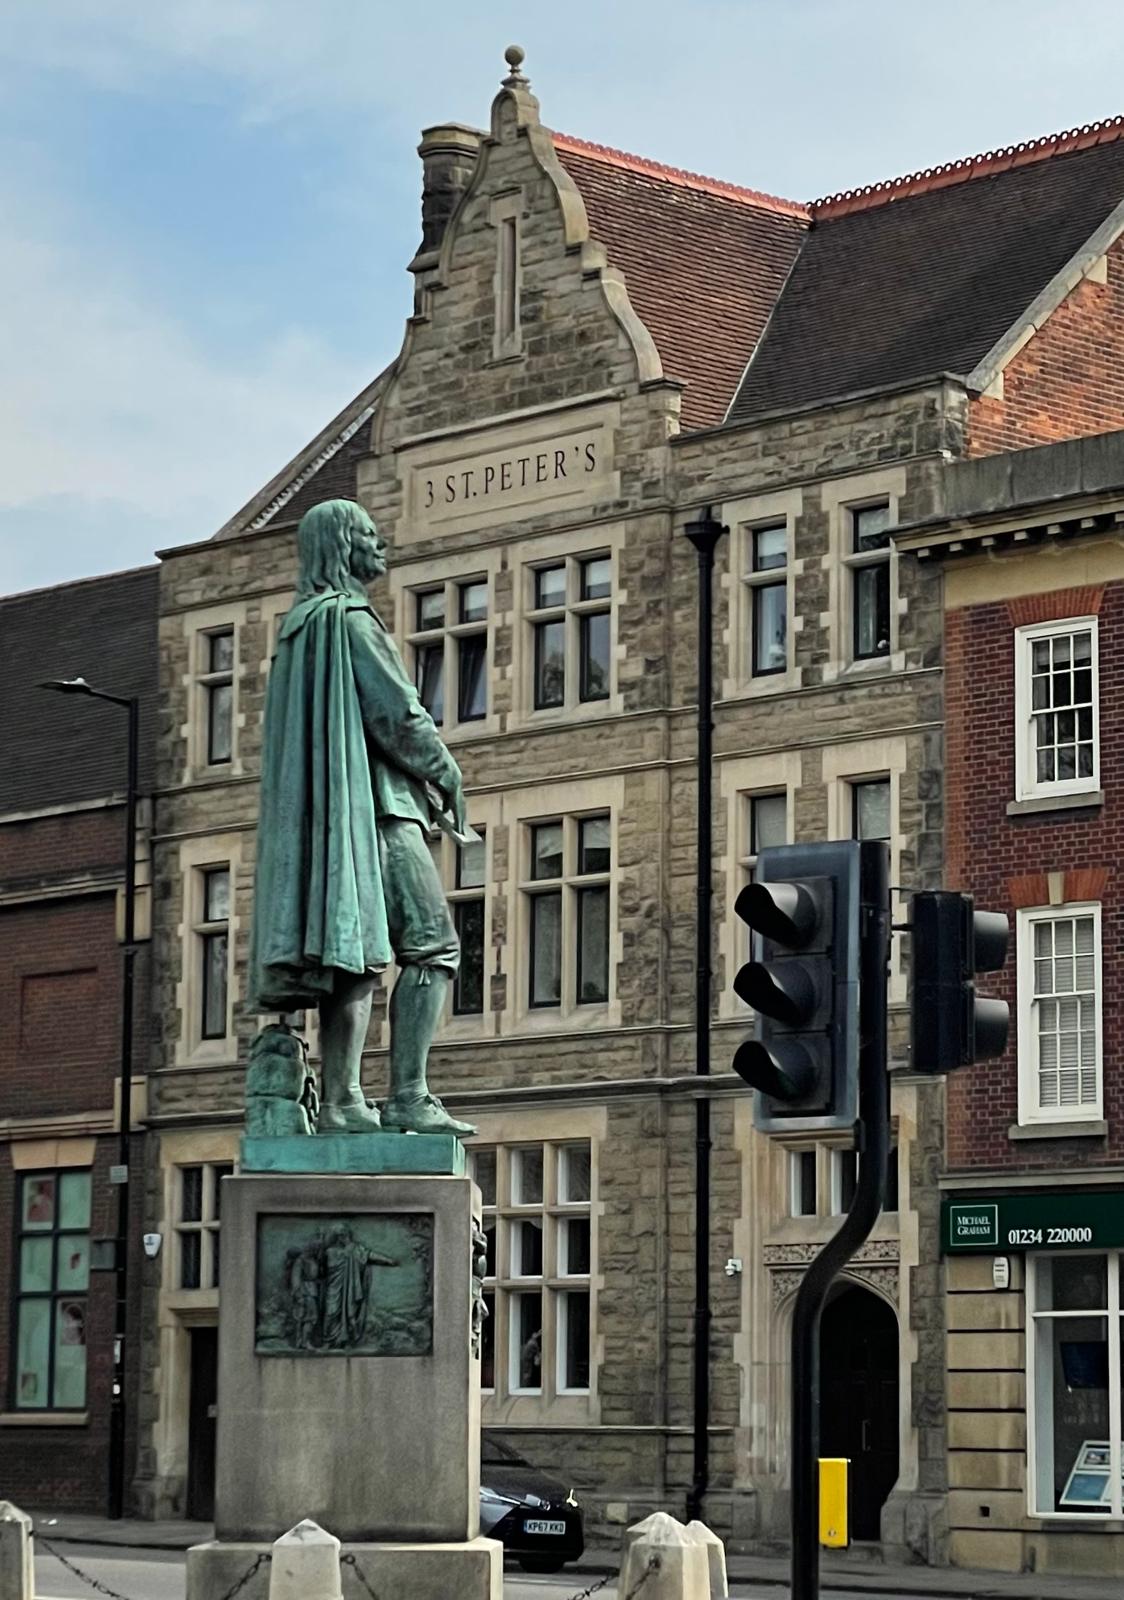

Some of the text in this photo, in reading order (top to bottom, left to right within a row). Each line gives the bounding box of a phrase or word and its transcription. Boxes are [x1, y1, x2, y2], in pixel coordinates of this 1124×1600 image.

[425, 480, 434, 508] 3
[957, 1216, 991, 1225] MICHAEL
[957, 1226, 990, 1235] GRAHAM
[1008, 1227, 1092, 1244] 01234 220000
